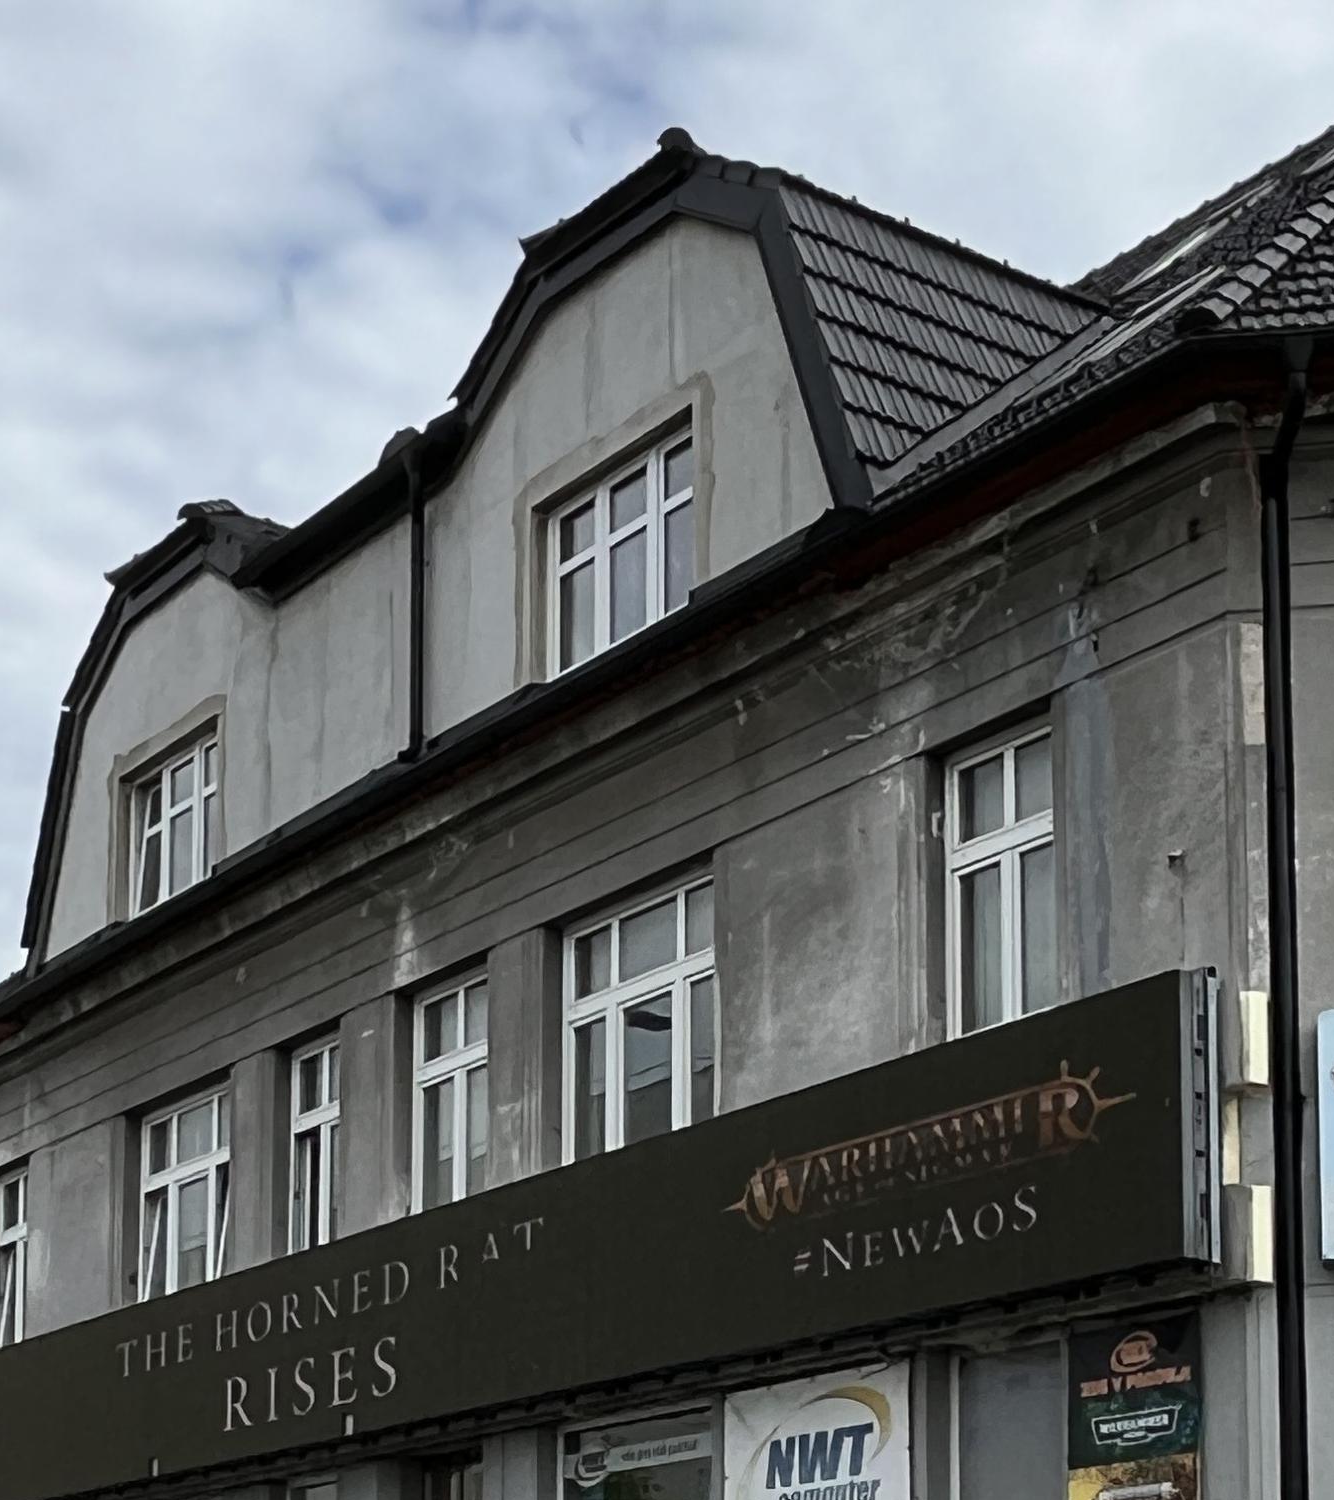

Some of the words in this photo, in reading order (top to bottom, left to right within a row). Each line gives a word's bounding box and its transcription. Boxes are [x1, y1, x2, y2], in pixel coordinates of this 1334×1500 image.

[116, 1323, 194, 1377] THE
[215, 1260, 410, 1352] HORNED
[438, 1217, 544, 1289] RAT
[223, 1336, 398, 1432] RISES
[766, 1421, 875, 1490] NWT
